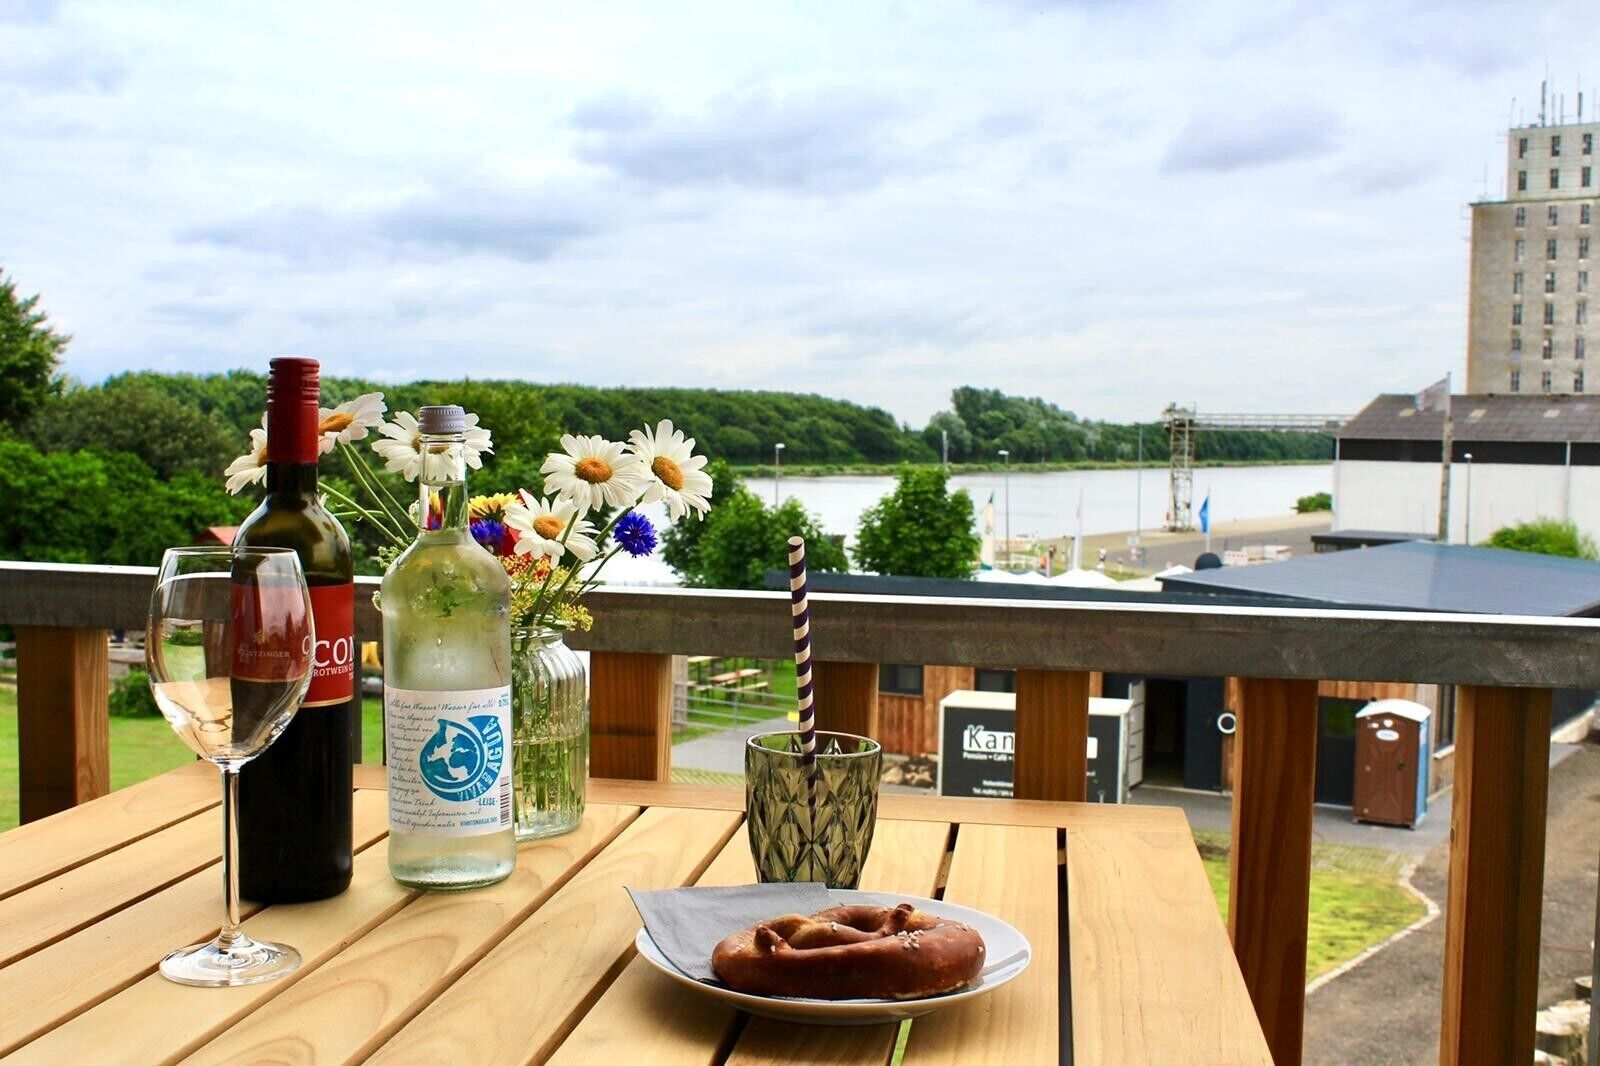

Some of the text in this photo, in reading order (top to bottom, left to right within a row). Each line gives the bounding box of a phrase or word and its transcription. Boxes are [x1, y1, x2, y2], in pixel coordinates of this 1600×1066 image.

[313, 664, 349, 677] ROTWEIN
[482, 716, 503, 772] AGUA
[481, 772, 494, 785] CON
[457, 780, 487, 801] VIVA
